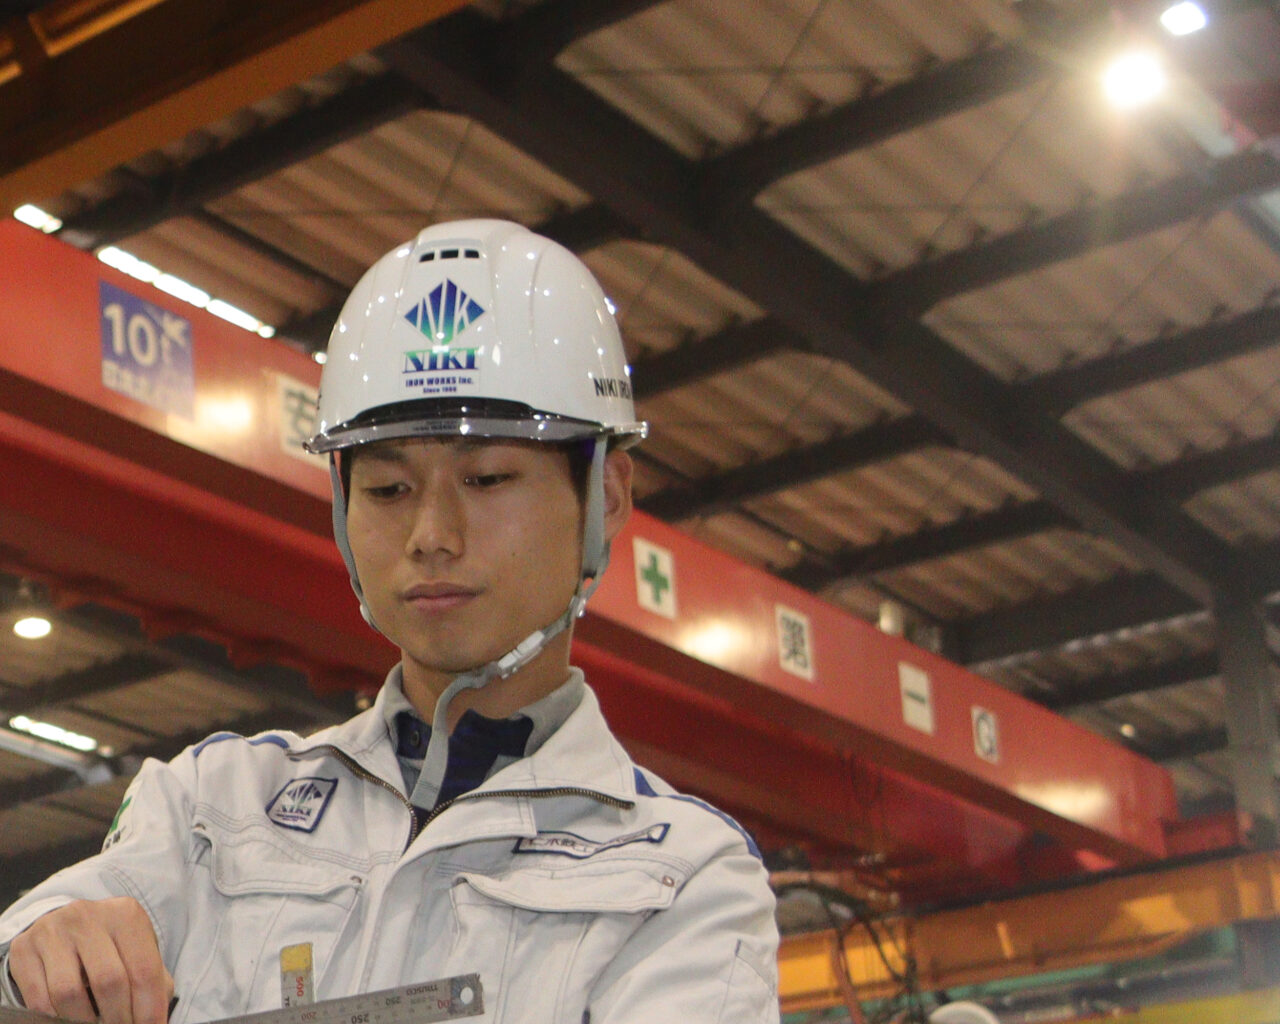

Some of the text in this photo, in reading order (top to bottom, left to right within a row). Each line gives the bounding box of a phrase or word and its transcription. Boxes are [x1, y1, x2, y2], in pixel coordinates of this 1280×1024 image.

[402, 347, 479, 374] NIKI
[427, 376, 456, 386] WORKS
[593, 378, 618, 397] NIKI
[350, 1013, 370, 1024] 250
